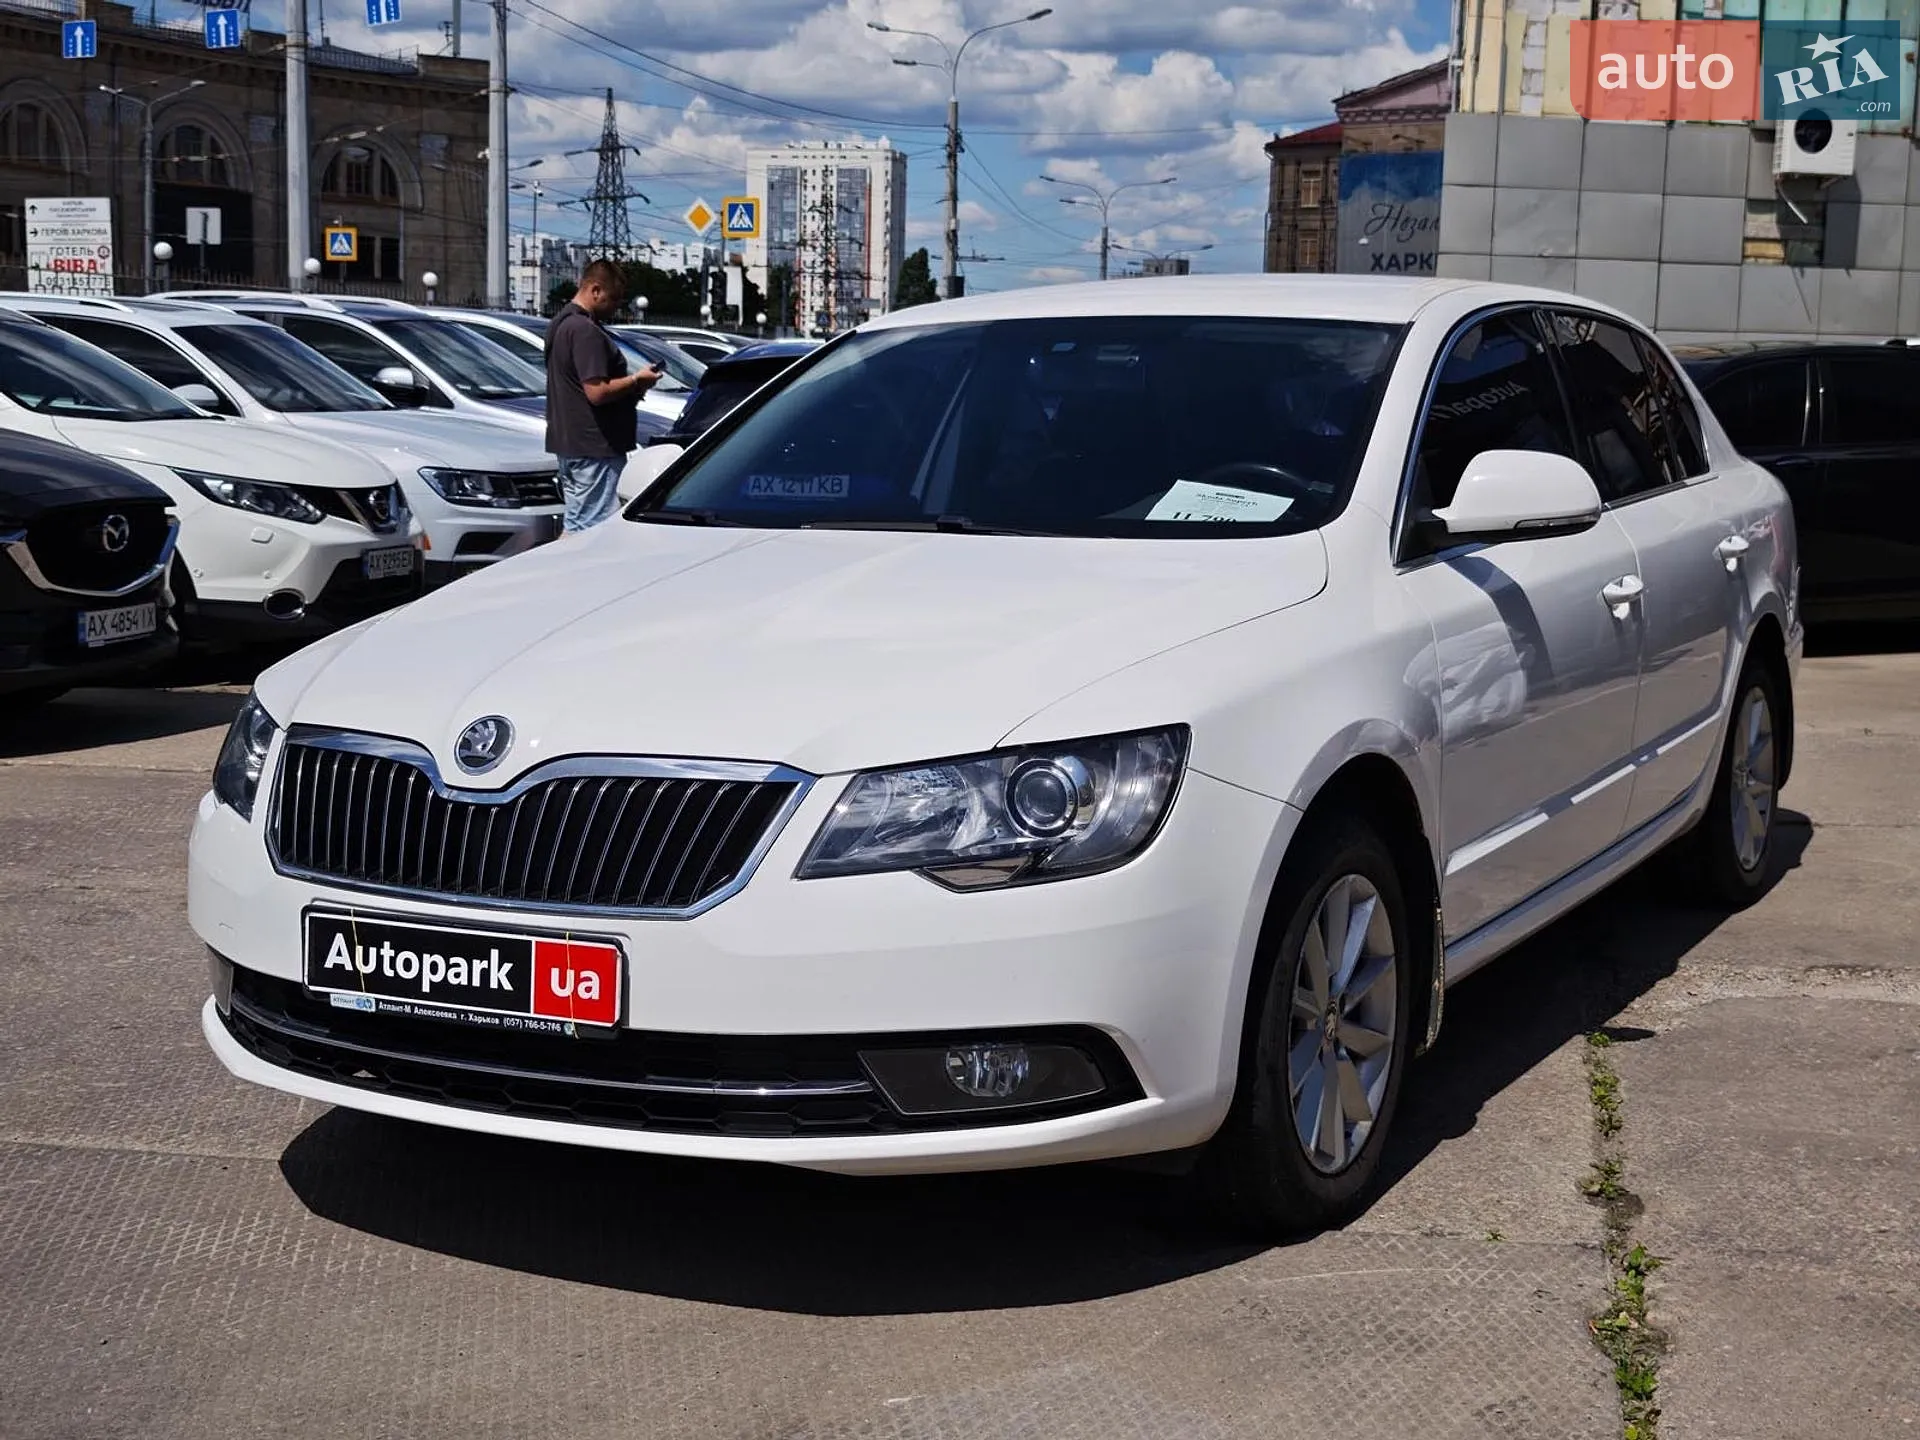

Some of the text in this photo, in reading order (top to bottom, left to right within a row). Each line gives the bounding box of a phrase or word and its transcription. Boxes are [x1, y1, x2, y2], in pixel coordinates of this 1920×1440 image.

[49, 247, 94, 256] ГОТЕЛЬ
[87, 615, 107, 637] AX
[111, 609, 138, 633] 4854
[324, 932, 601, 1001] Autopark ua
[414, 1006, 457, 1020] Алексеевка
[468, 1013, 500, 1026] Харьков
[502, 1018, 523, 1030] (057)
